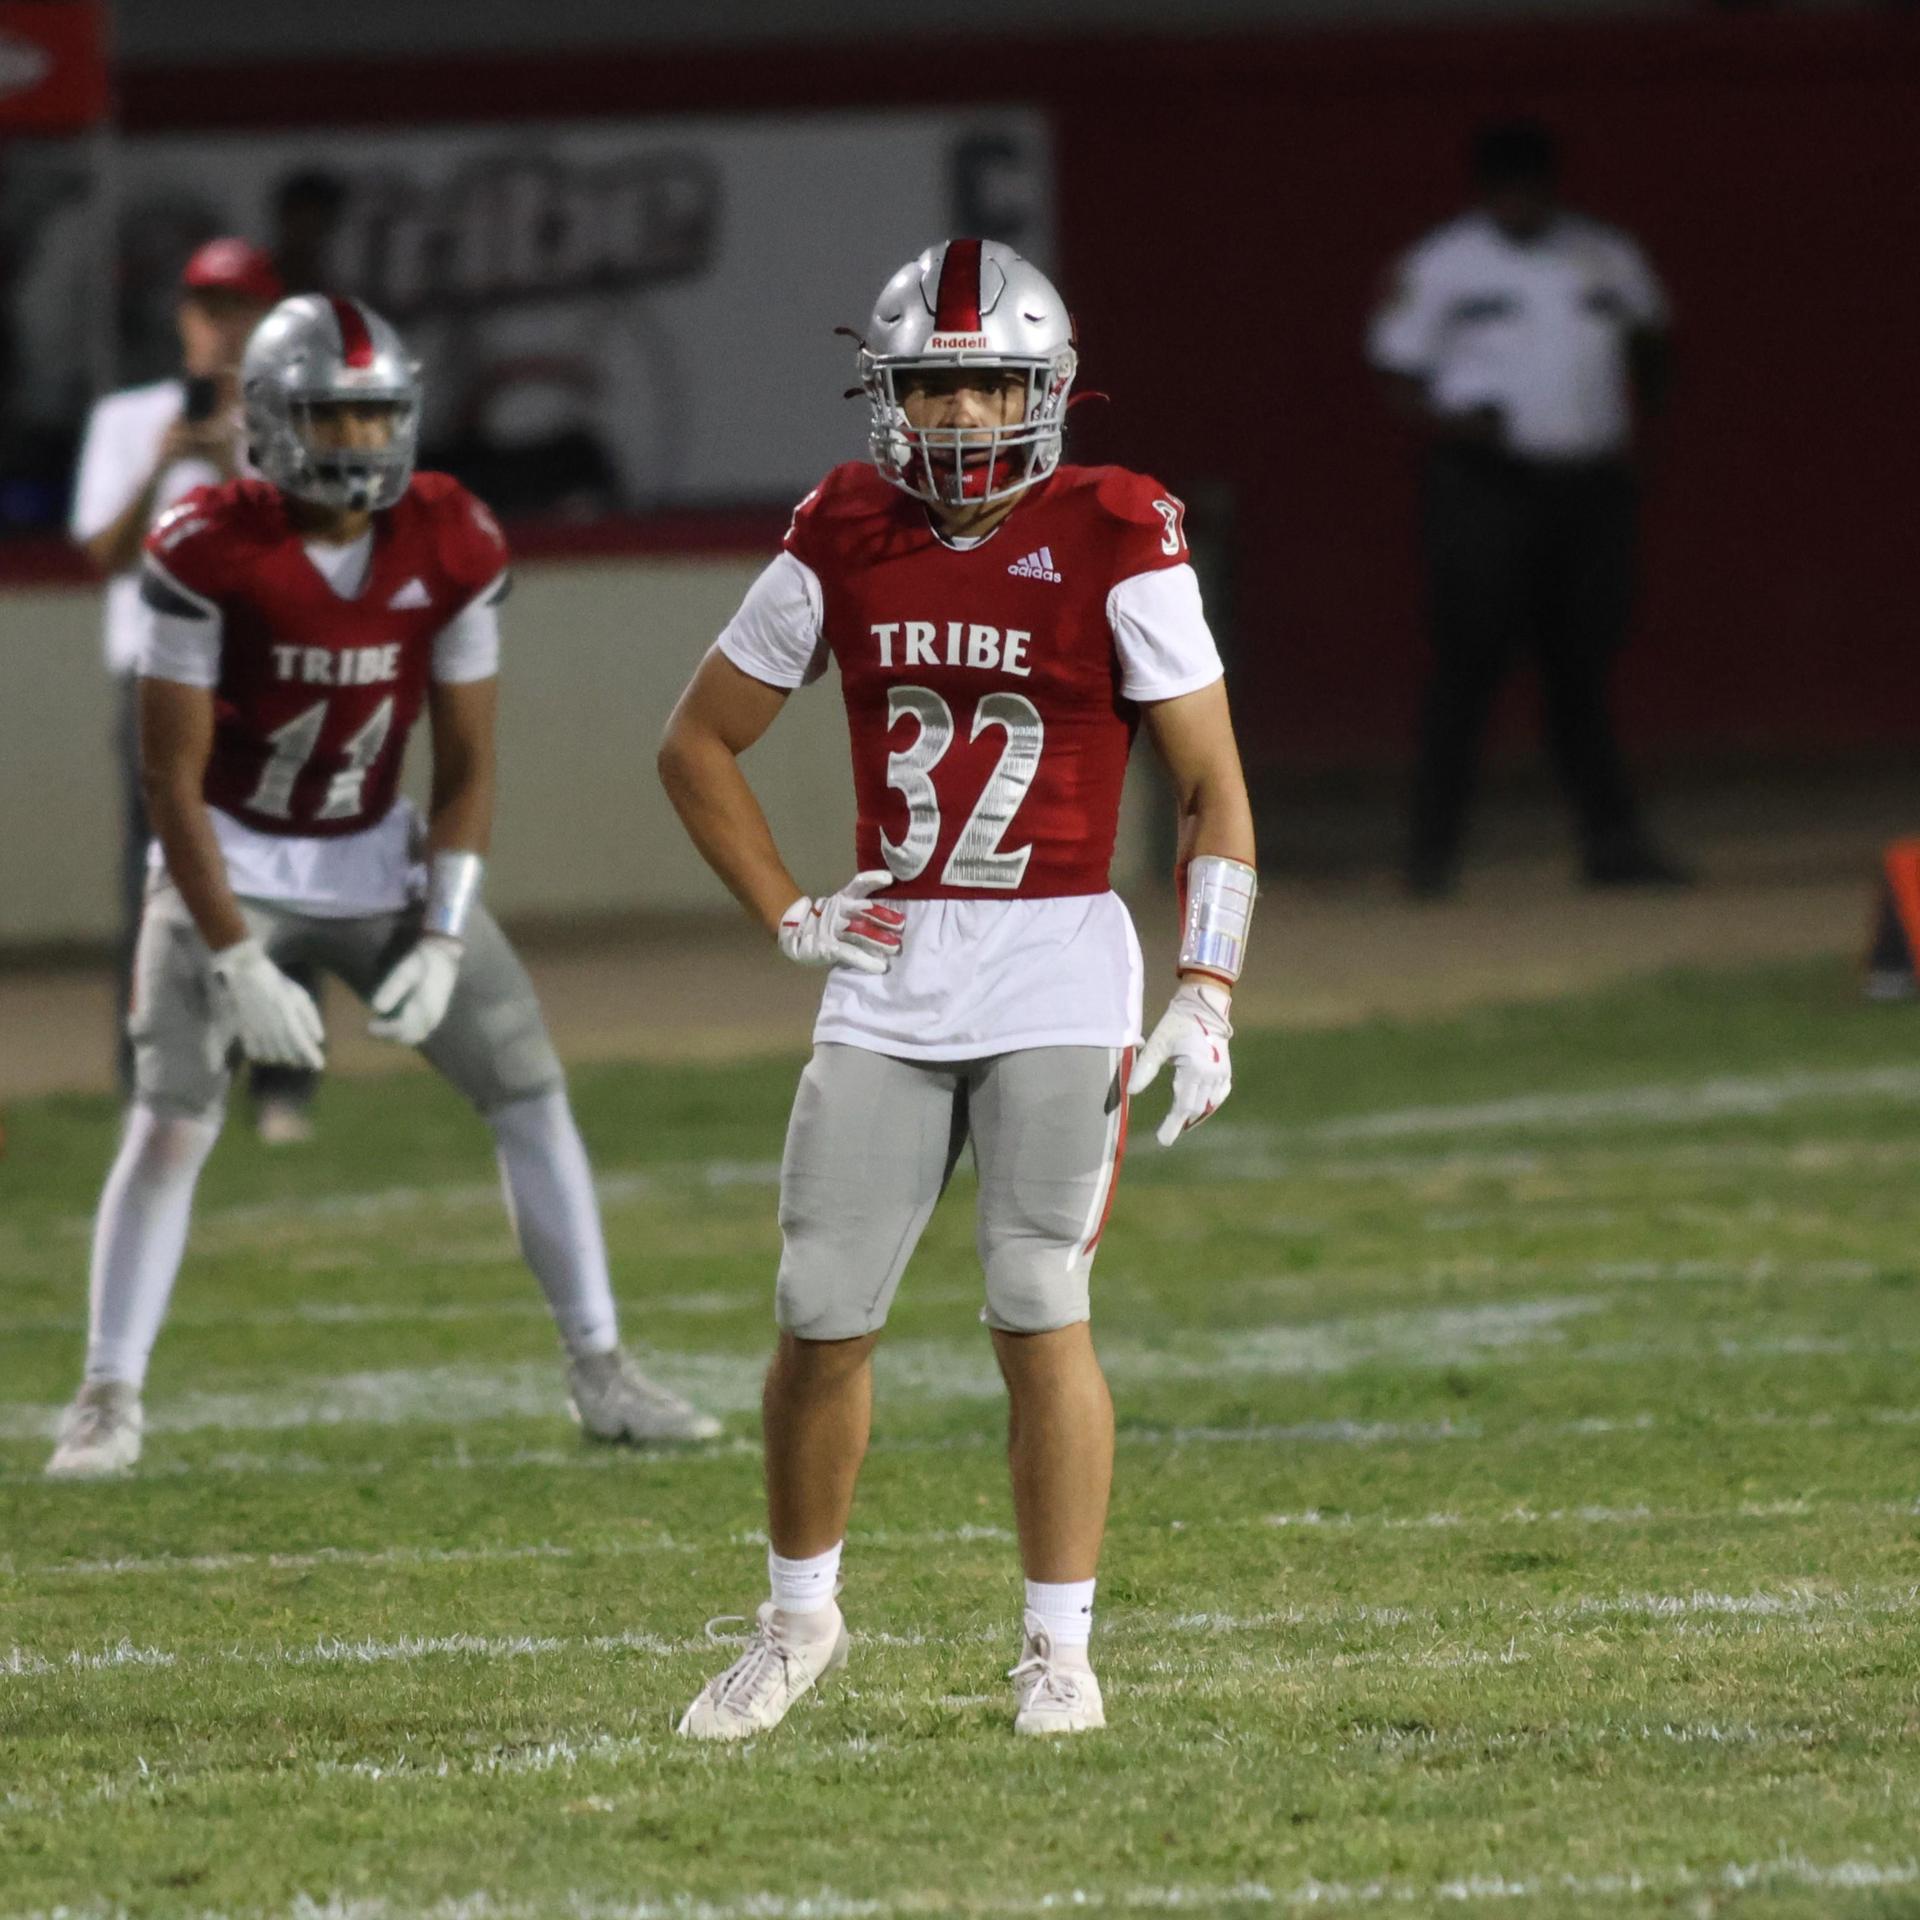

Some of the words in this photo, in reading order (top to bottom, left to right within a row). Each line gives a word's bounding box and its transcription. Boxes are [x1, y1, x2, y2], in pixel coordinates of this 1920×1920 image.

[931, 337, 987, 348] Riddell
[1007, 564, 1062, 583] adidas
[272, 642, 402, 686] TRIBE
[870, 621, 1032, 677] TRIBE
[245, 696, 394, 821] 11
[879, 685, 1044, 889] 32
